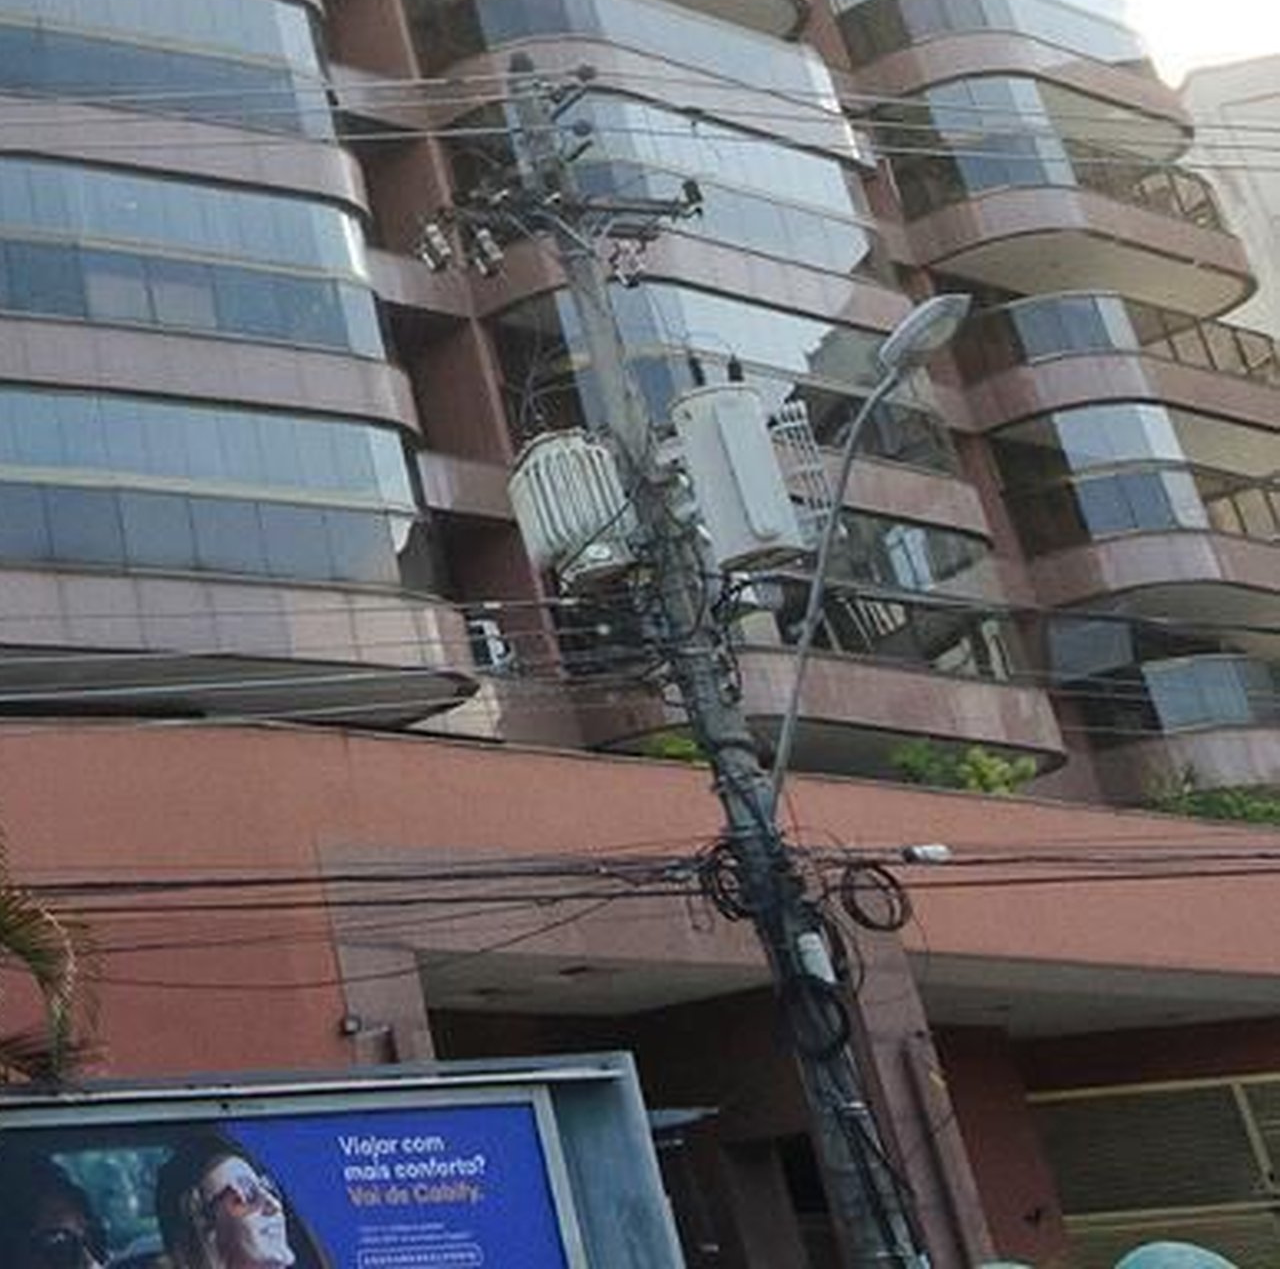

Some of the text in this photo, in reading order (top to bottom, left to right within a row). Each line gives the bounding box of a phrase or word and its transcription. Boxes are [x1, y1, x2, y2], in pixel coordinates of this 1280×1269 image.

[338, 1135, 445, 1159] Viajar com
[344, 1155, 486, 1181] mais conforto?
